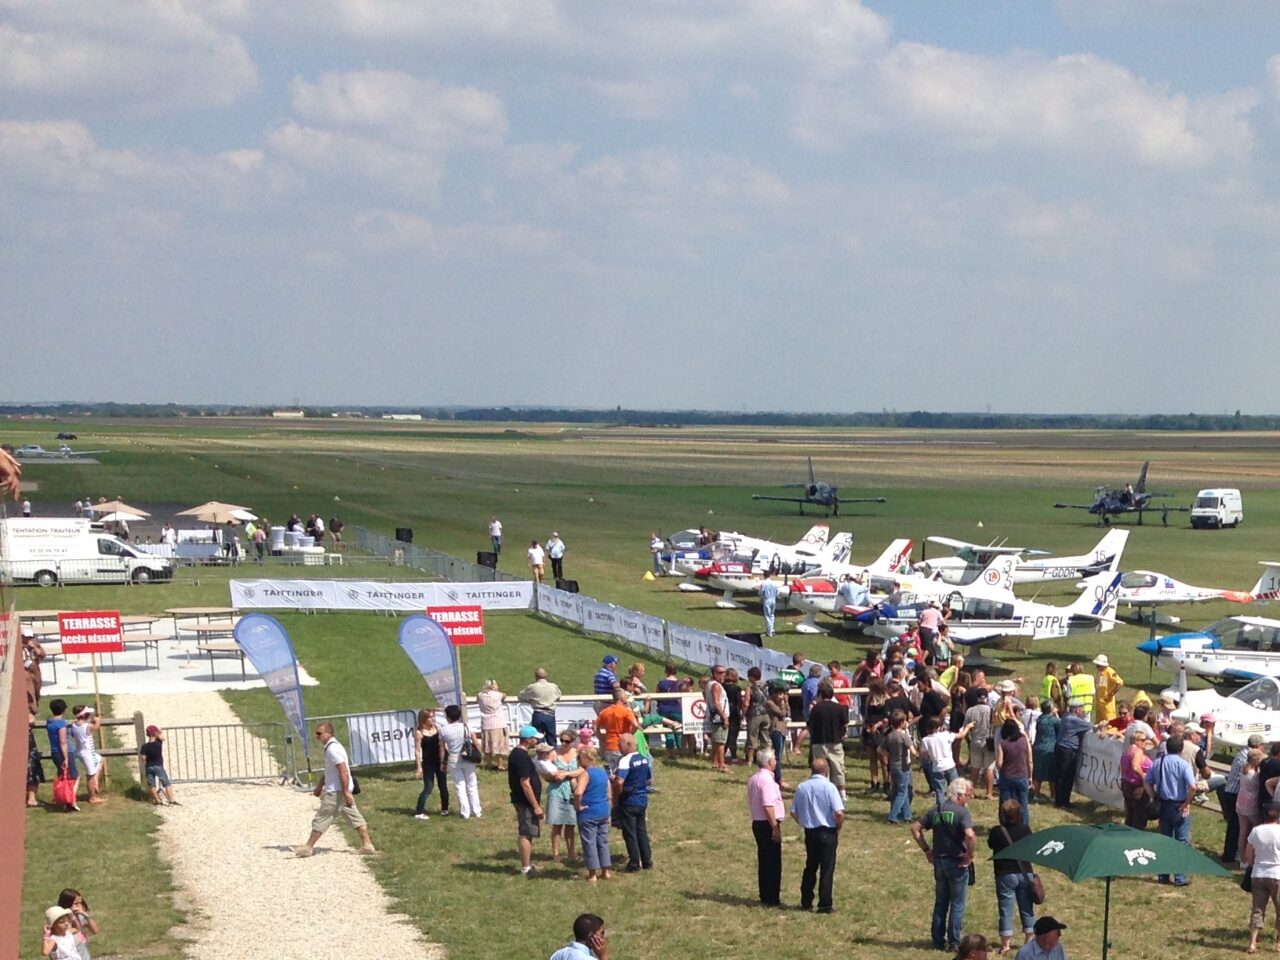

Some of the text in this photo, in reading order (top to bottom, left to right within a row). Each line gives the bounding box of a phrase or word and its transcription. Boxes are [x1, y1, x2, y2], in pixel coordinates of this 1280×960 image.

[1094, 550, 1107, 562] 15
[1042, 568, 1076, 578] F-GDDR
[263, 589, 522, 600] TAITTINGER TAITTINGER TAITTINGER
[430, 610, 480, 623] TERRASSE
[1022, 615, 1067, 629] F-GTPL
[62, 617, 117, 630] TERRASSE
[453, 625, 483, 636] RÉSERVÉ
[62, 632, 121, 645] ACCÈS RÉSERVÉ
[782, 673, 800, 683] WC
